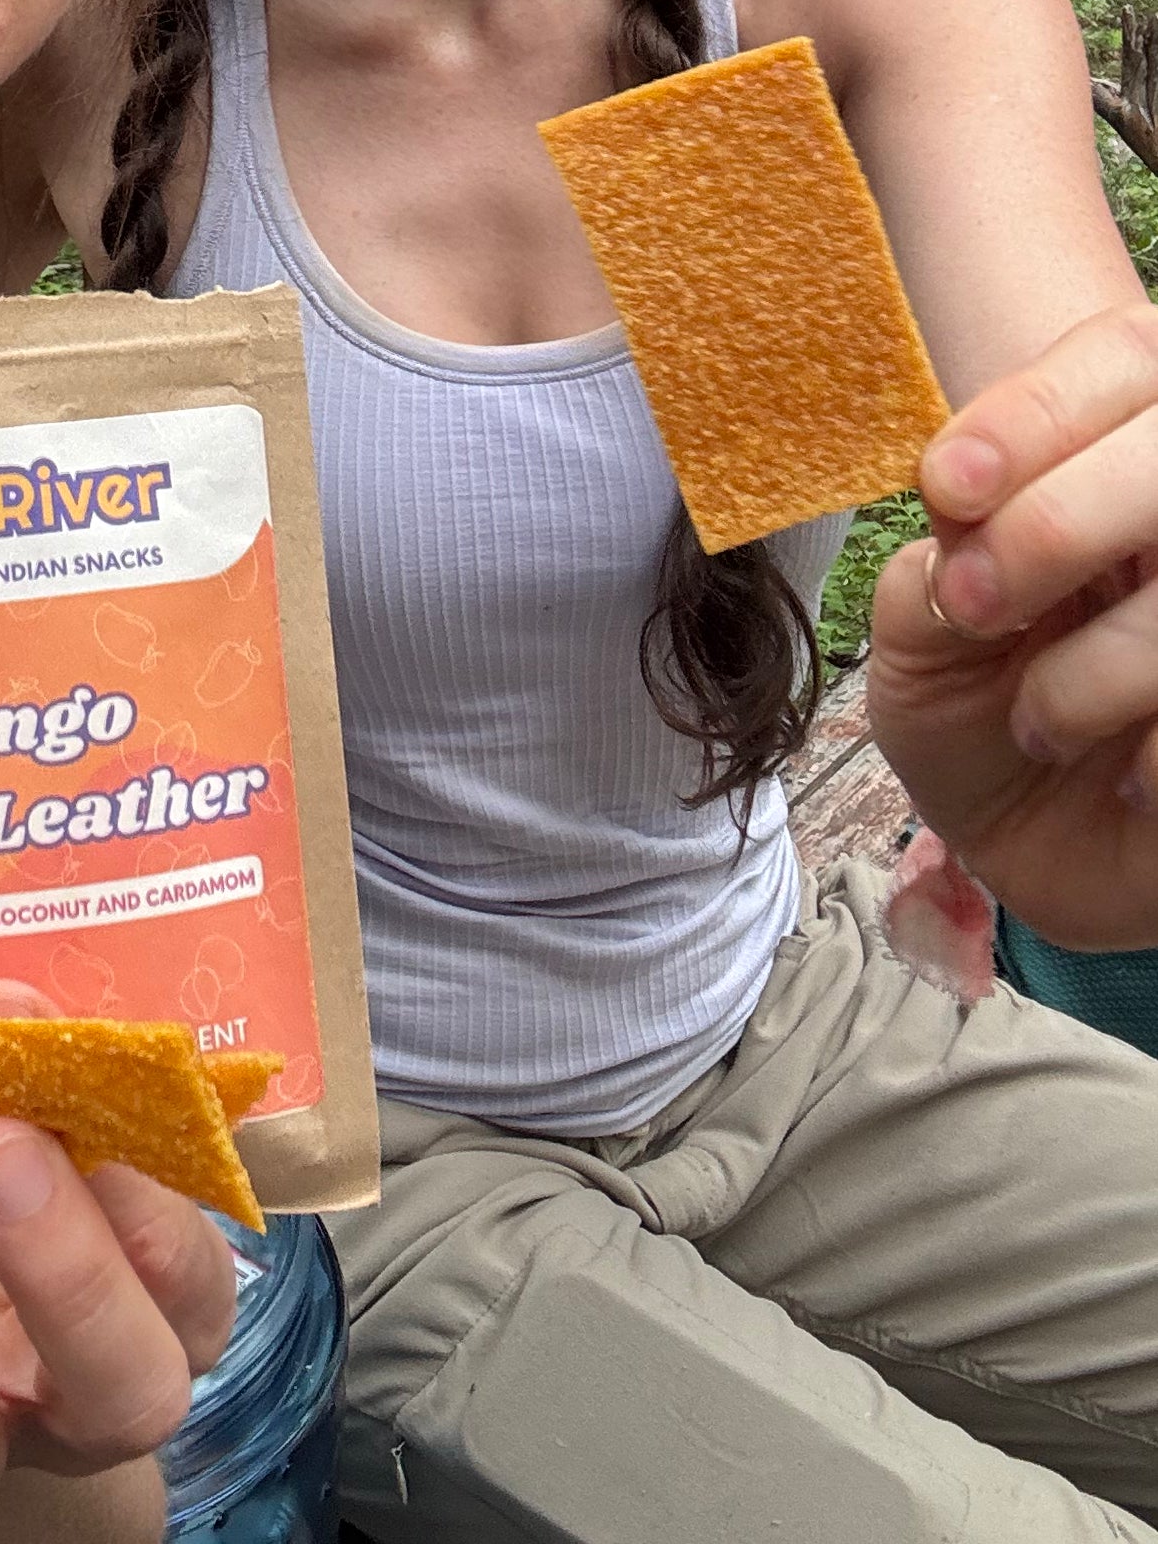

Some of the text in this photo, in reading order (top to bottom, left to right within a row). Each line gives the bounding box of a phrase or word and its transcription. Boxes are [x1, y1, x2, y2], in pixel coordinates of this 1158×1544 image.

[74, 546, 163, 575] SNACKS
[96, 891, 140, 915] AND
[146, 868, 256, 908] CARDAMOM
[197, 1016, 248, 1052] ENT
